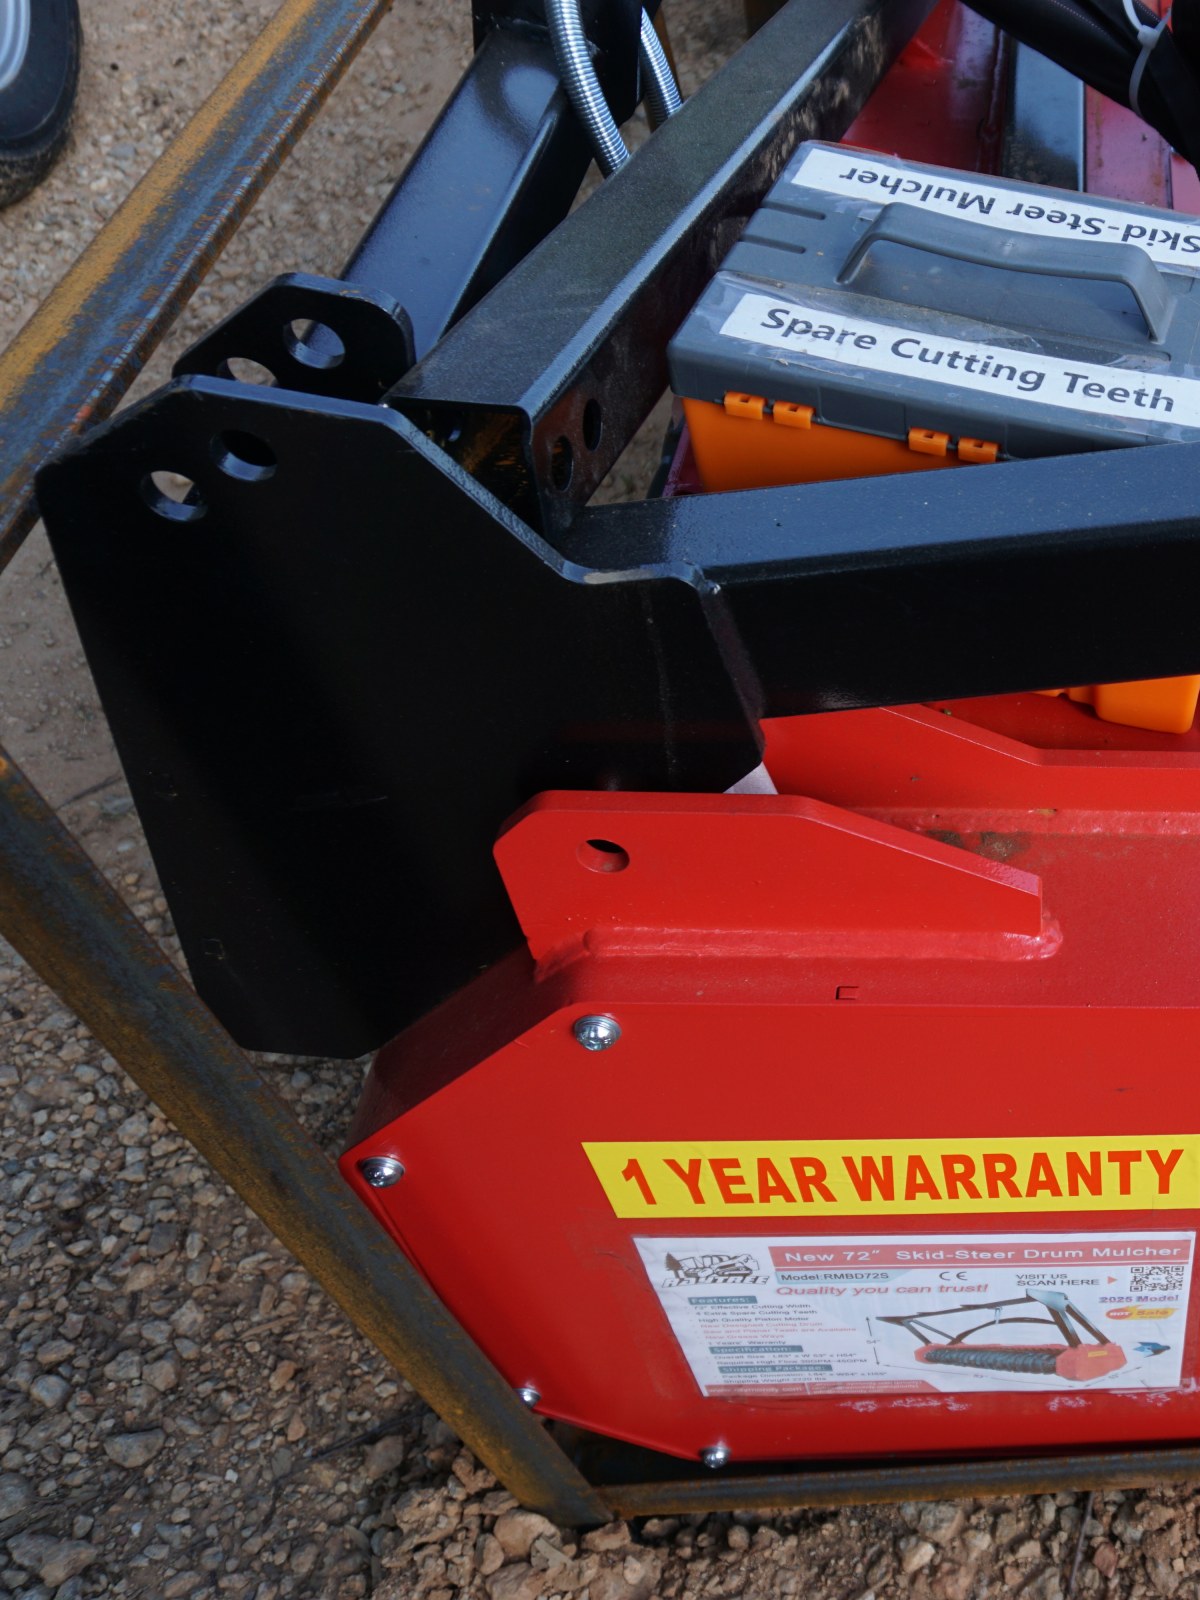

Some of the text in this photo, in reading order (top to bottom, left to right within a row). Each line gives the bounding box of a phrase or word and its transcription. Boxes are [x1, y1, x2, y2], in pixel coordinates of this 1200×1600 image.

[838, 167, 996, 216] Mulcher
[760, 308, 1175, 413] Spare Cutting Teeth
[621, 1148, 1184, 1205] 1 YEAR WARRANTY
[784, 1252, 835, 1262] New
[895, 1249, 1015, 1260] Skid-Steer
[1024, 1249, 1083, 1259] Drum
[1092, 1247, 1181, 1257] Mulcher
[1060, 1278, 1100, 1286] HERE
[776, 1284, 988, 1297] Quality you can trust!
[690, 1296, 749, 1304] Features:
[1098, 1294, 1179, 1304] 2025 Model
